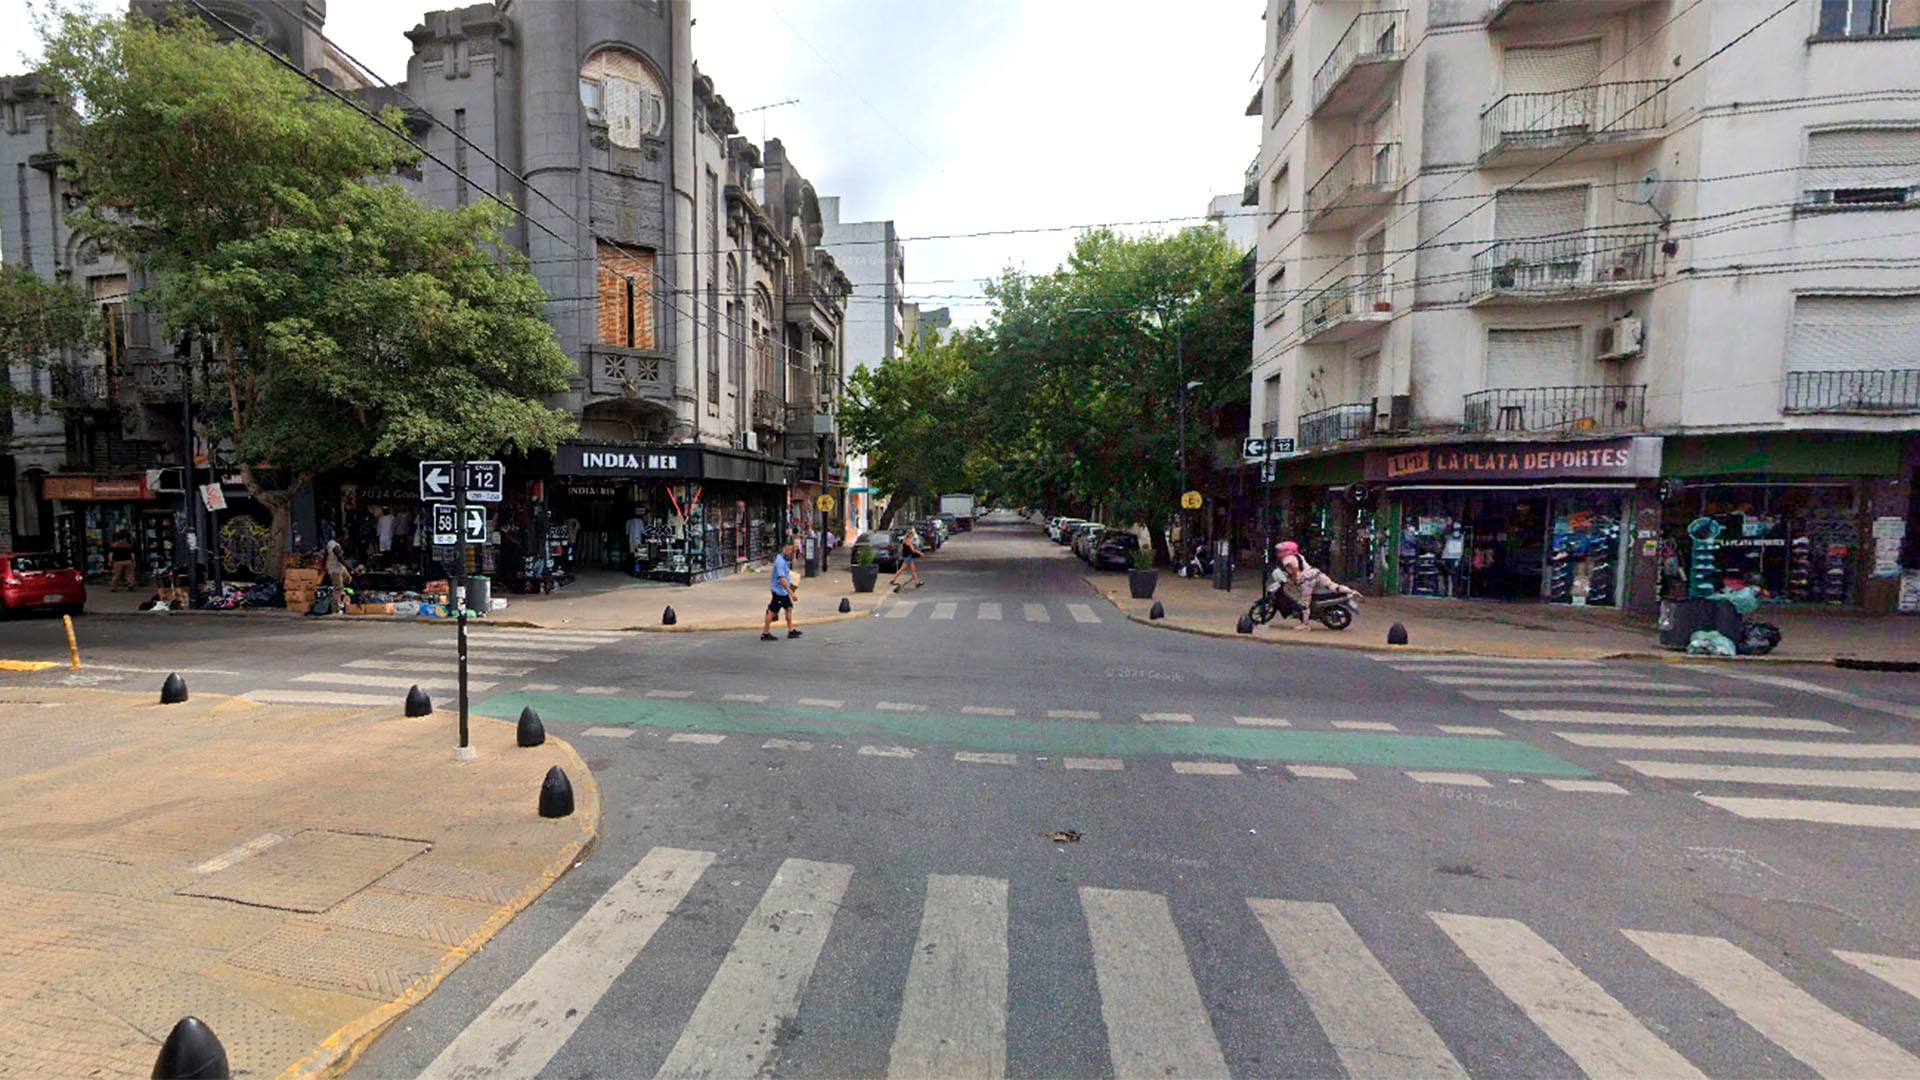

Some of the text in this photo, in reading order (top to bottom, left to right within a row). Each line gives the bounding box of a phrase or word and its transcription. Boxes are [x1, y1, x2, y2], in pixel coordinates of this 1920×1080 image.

[1277, 442, 1291, 452] 12
[583, 453, 678, 469] INDIA MEN
[1438, 448, 1629, 470] LA PLATA DEPORTES
[475, 472, 494, 488] 12
[567, 487, 615, 496] INDIA MEN
[438, 515, 452, 531] 58
